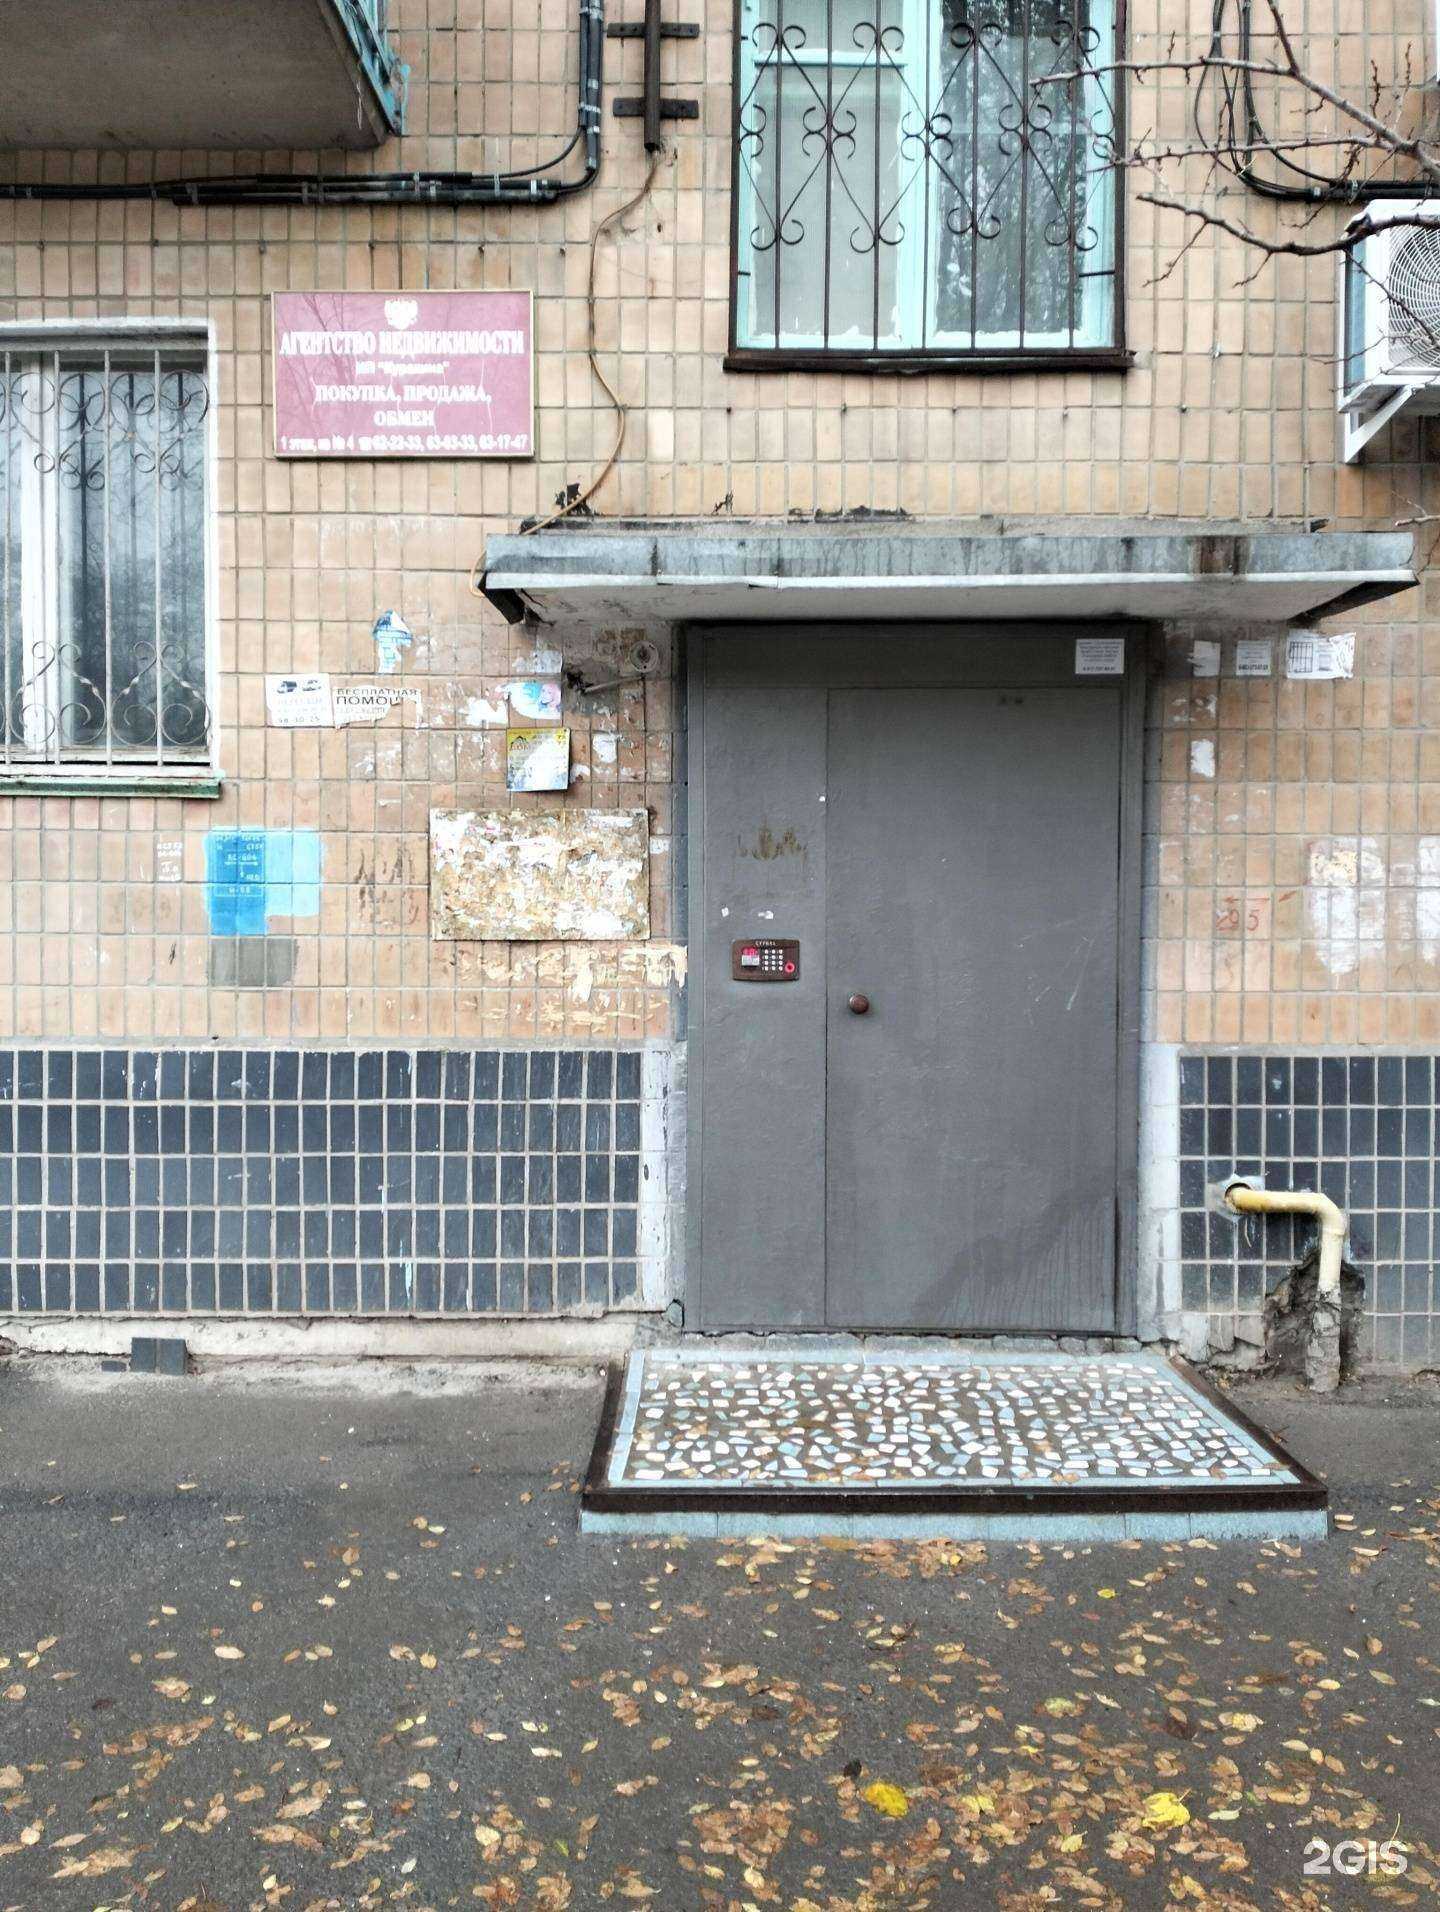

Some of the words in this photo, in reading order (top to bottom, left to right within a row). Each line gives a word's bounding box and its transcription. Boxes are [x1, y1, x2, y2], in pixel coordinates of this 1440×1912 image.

[279, 331, 377, 355] АГЕНТСТВО
[379, 331, 525, 356] НЕДВИЖИМОСТИ
[374, 410, 435, 427] ОБМЕН
